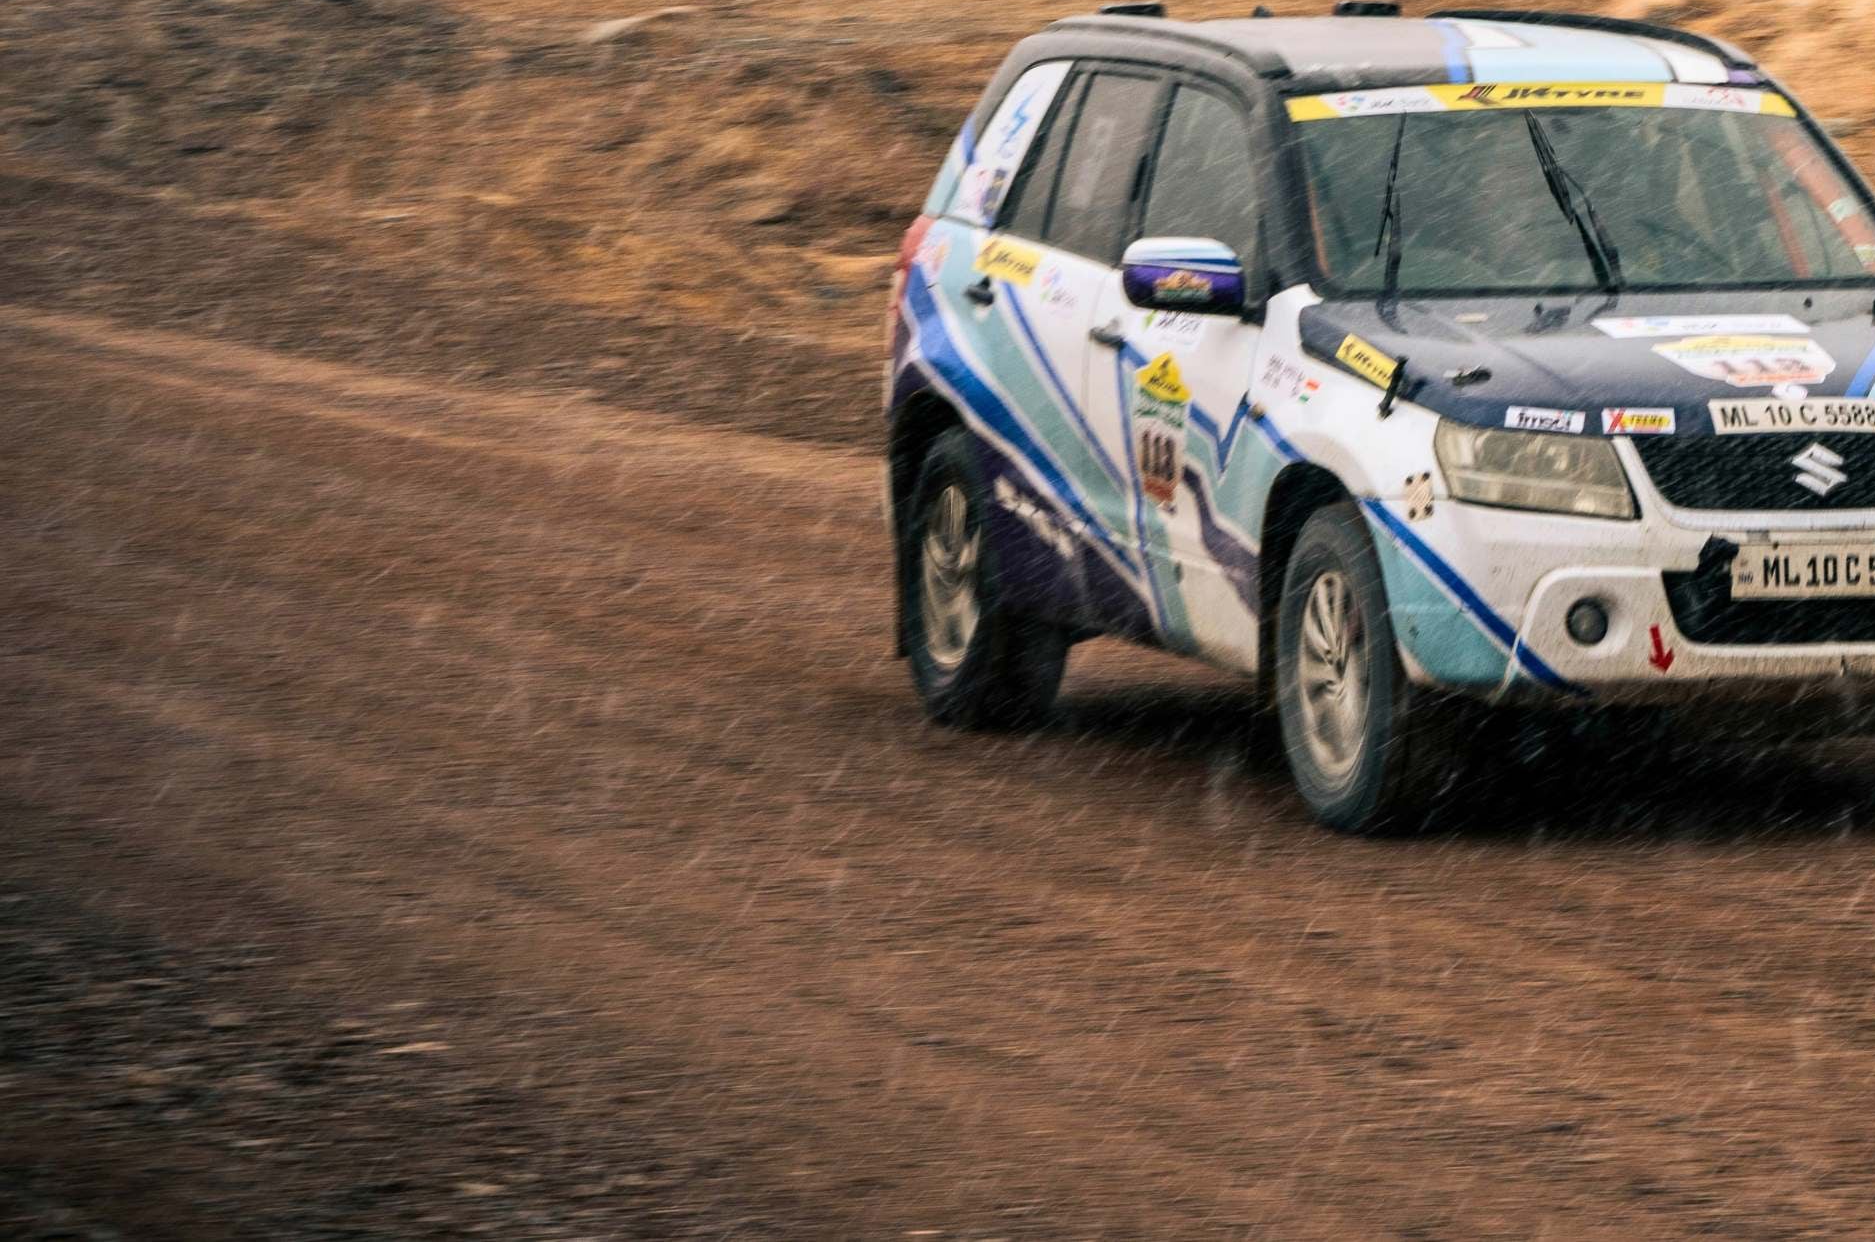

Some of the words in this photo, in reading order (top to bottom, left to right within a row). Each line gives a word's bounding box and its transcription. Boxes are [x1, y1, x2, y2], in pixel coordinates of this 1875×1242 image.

[1720, 404, 1758, 428] ML
[1765, 403, 1792, 427] 10
[1800, 403, 1818, 426] C
